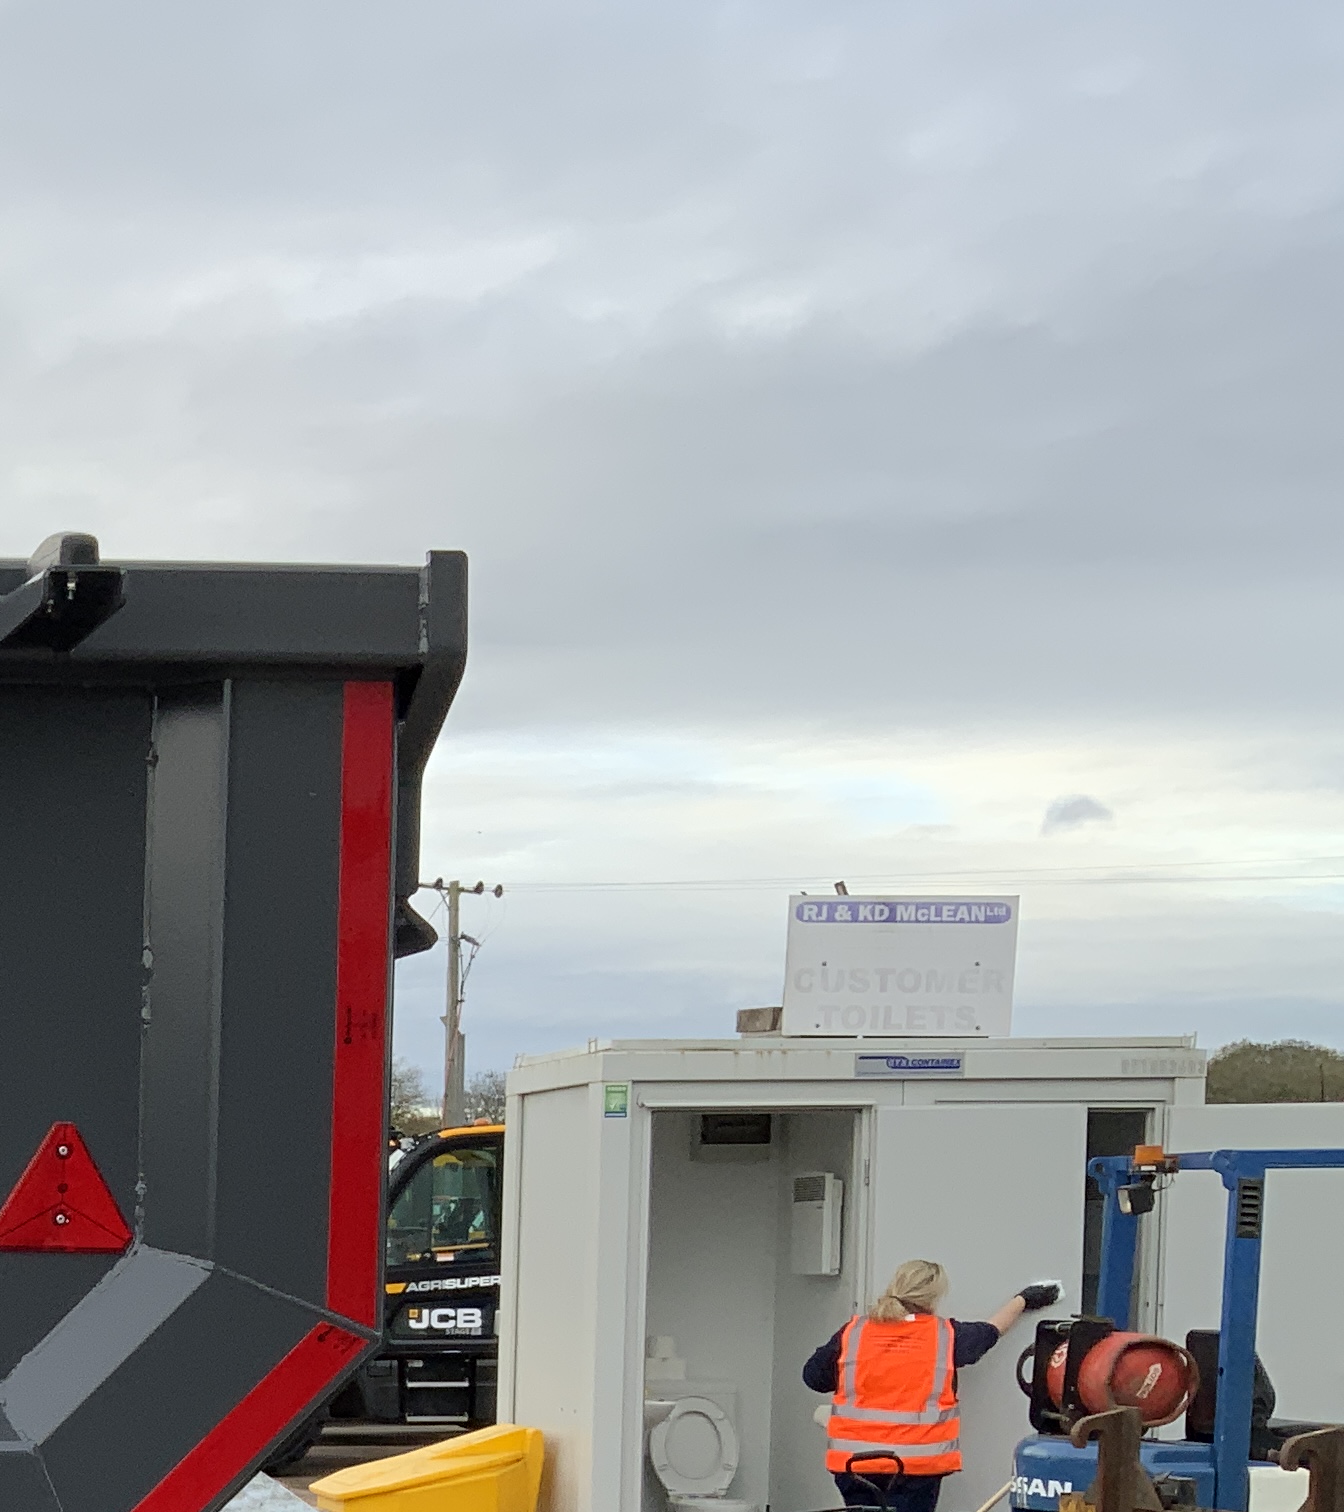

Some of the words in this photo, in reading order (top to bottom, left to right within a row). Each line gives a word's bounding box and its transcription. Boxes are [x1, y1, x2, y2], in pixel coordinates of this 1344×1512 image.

[802, 904, 828, 921] RJ
[833, 904, 853, 921] &
[858, 904, 890, 921] KD
[896, 904, 985, 922] McLEAN
[793, 967, 1005, 994] CUSTOMER
[817, 1004, 977, 1031] TOILETS
[408, 1308, 483, 1329] JCB
